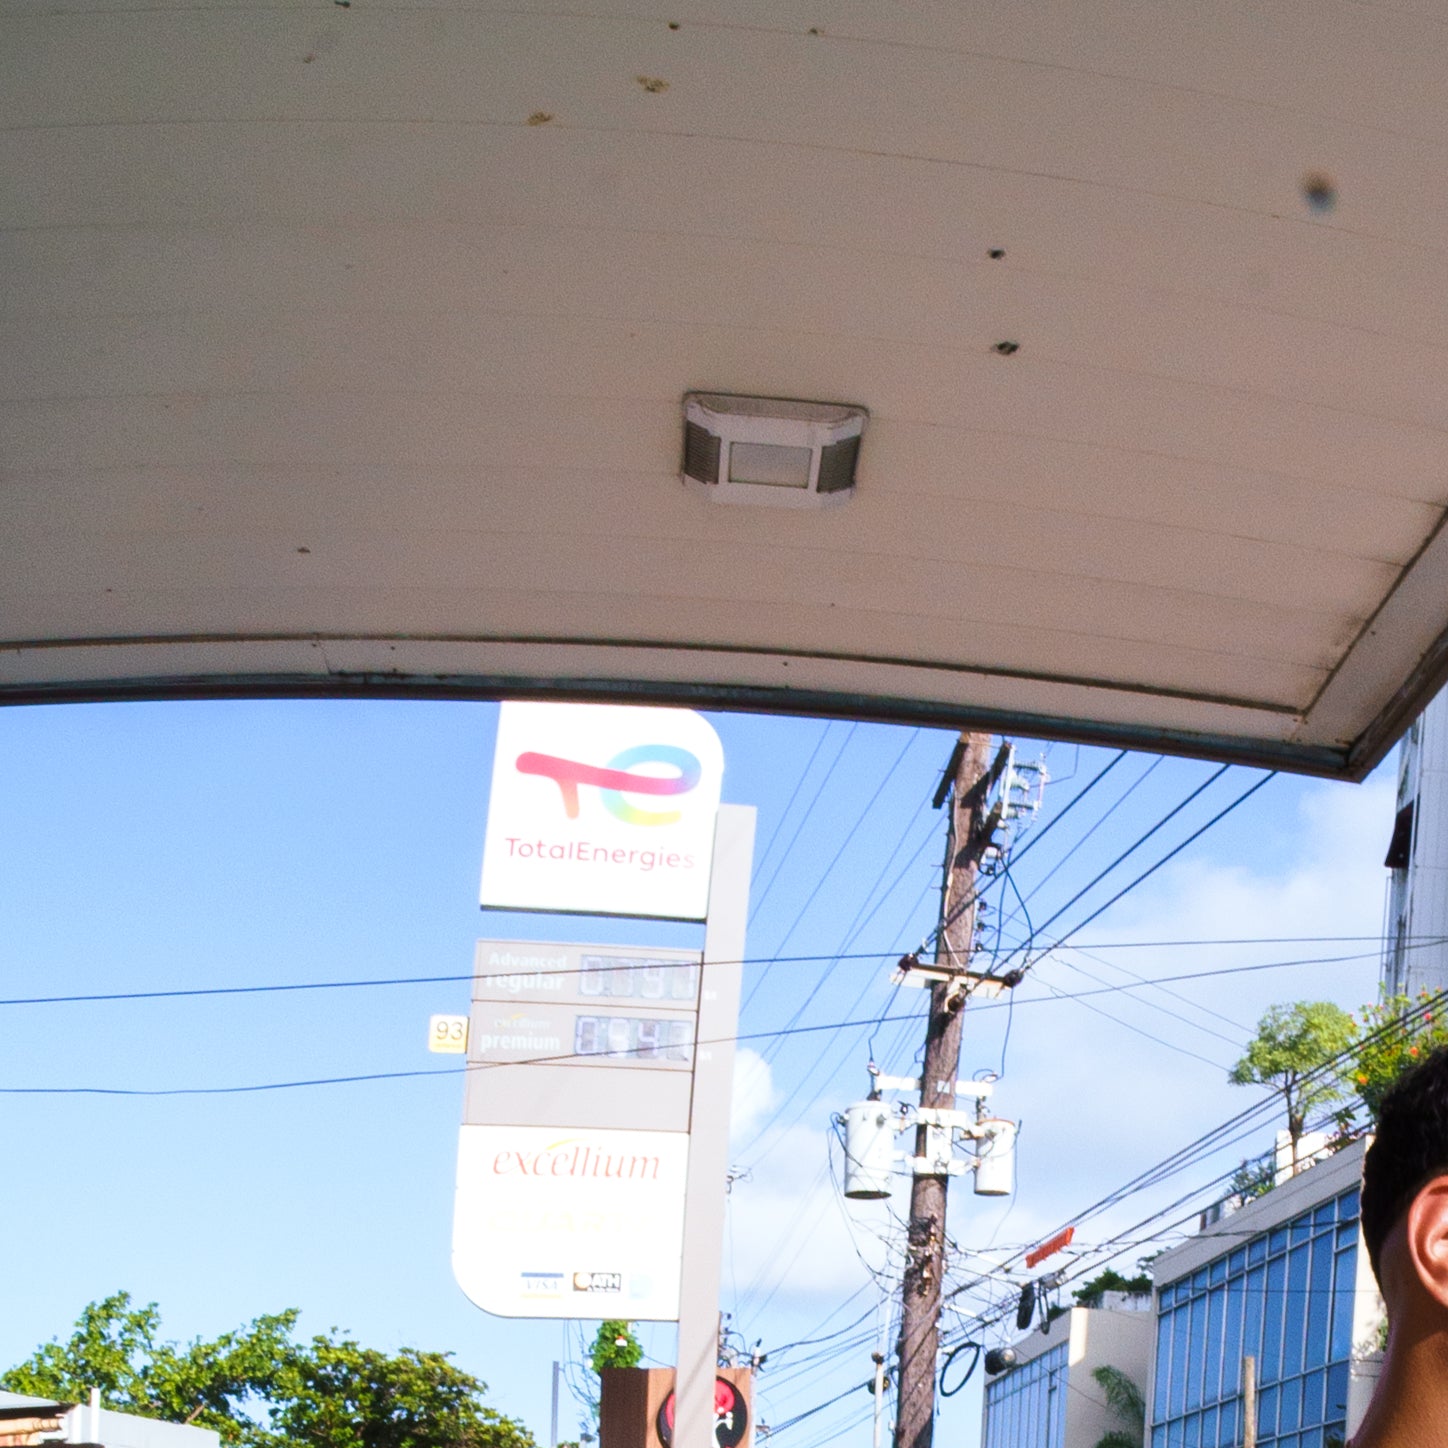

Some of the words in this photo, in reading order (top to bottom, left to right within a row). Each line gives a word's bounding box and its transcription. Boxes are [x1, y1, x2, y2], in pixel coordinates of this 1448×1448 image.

[505, 838, 695, 871] TotalEnergies
[436, 1021, 463, 1040] 93
[480, 1031, 560, 1052] premium
[493, 1146, 659, 1180] excellium
